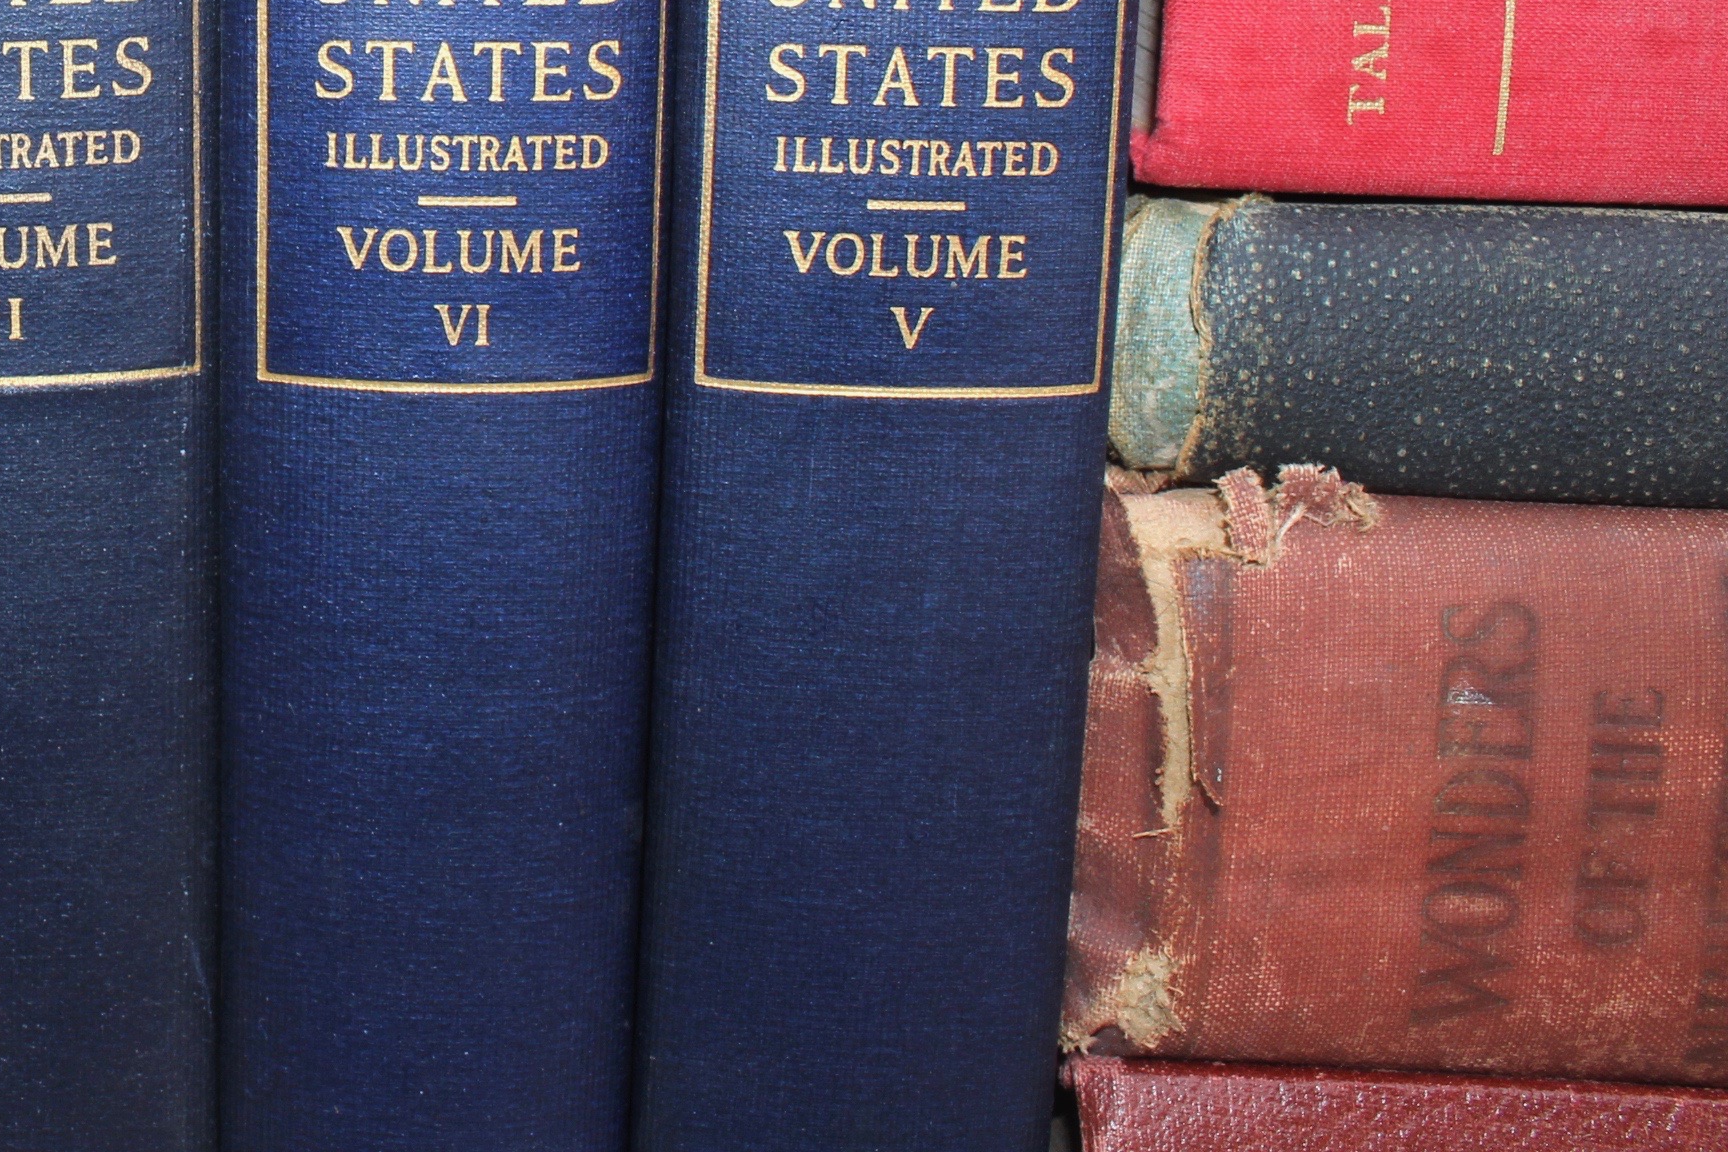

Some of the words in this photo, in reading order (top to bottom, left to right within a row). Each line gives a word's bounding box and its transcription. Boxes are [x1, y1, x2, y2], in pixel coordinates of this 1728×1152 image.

[317, 40, 623, 101] STATES
[768, 43, 1076, 108] STATES
[328, 134, 609, 172] ILLUSTRATED
[777, 137, 1060, 176] ILLUSTRATED
[339, 227, 582, 274] VOLUME
[786, 231, 1028, 279] VOLUME
[437, 305, 491, 346] VI
[892, 307, 934, 349] V
[1586, 688, 1665, 829] THE
[1412, 601, 1540, 1028] WONDERS
[1575, 854, 1650, 946] OF
